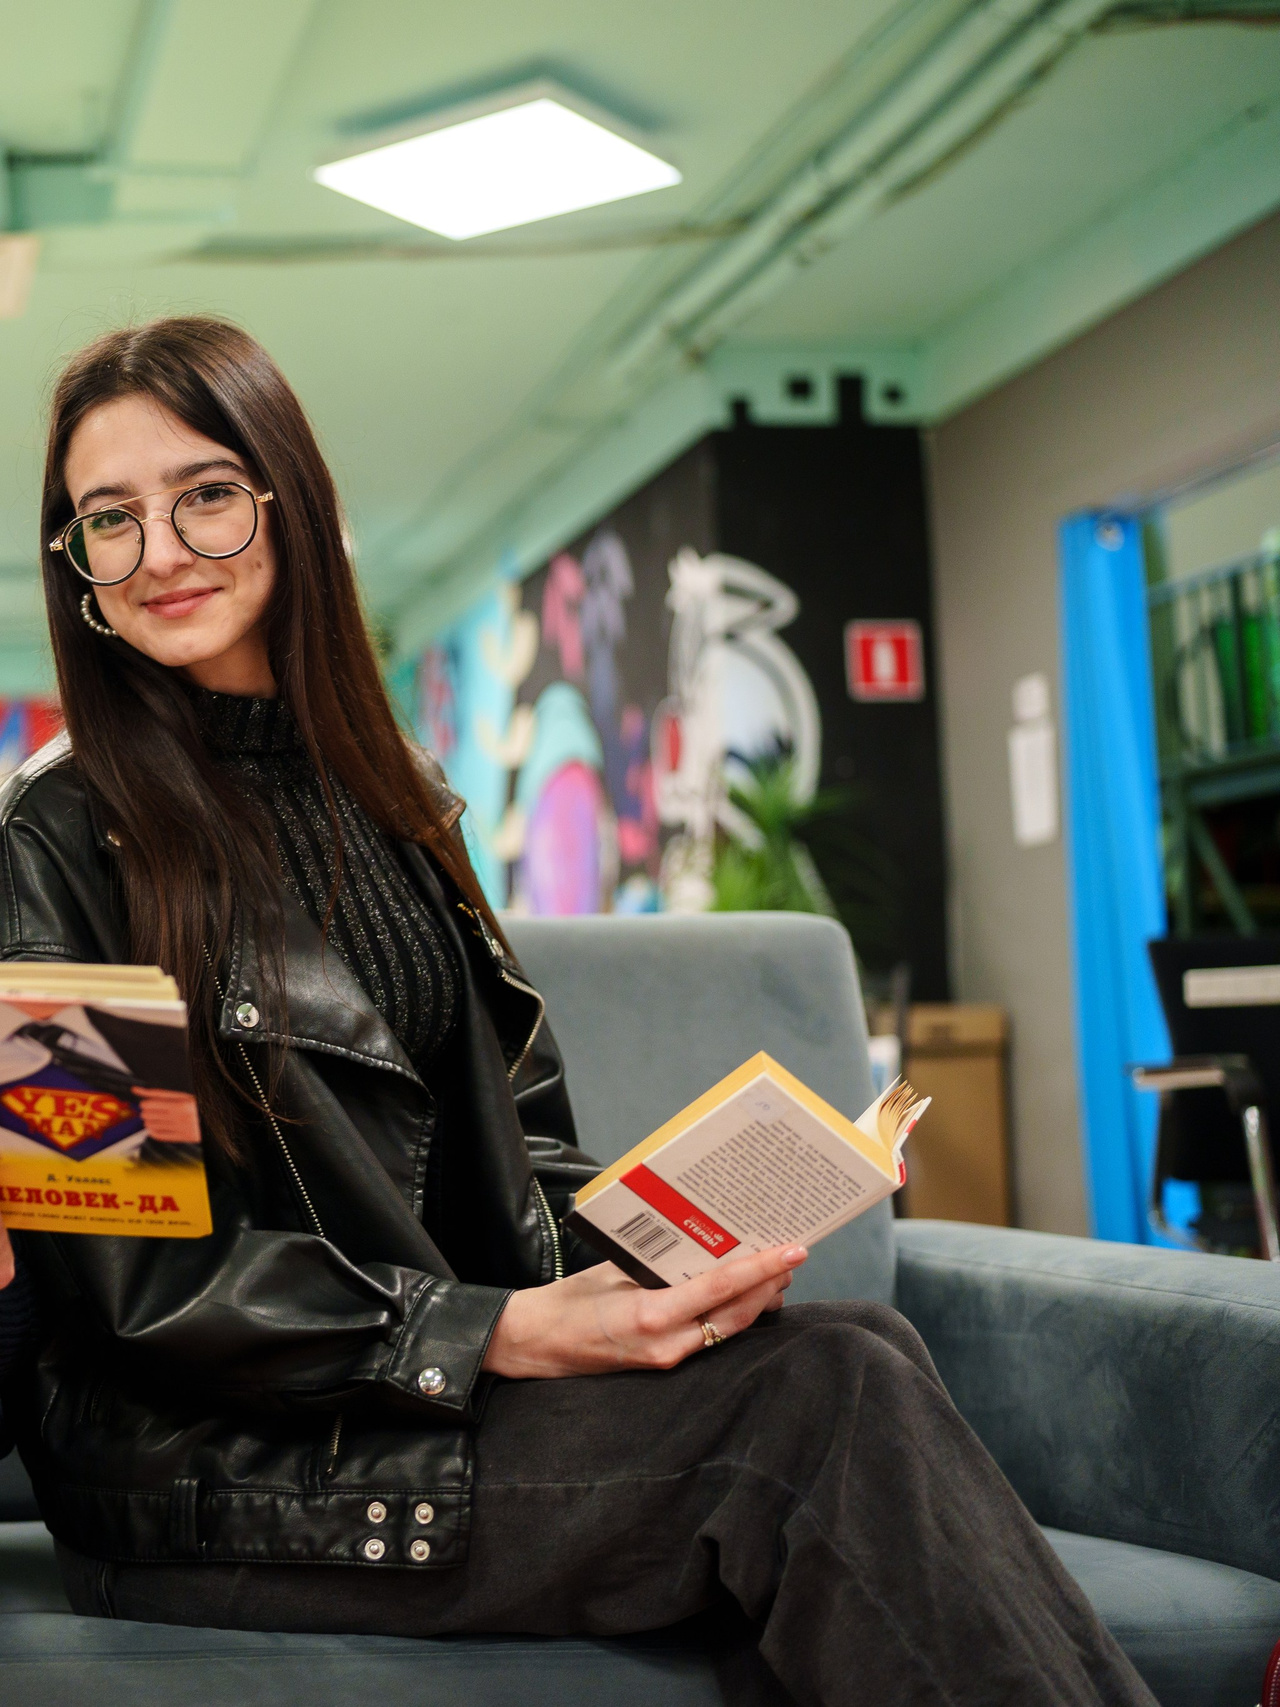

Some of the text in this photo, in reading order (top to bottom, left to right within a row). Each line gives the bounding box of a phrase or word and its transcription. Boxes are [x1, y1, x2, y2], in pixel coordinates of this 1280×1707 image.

[9, 1090, 125, 1122] YES
[26, 1117, 104, 1140] MAN
[683, 1219, 719, 1248] СТЕРВЫ
[690, 1214, 715, 1236] ШКОЛА
